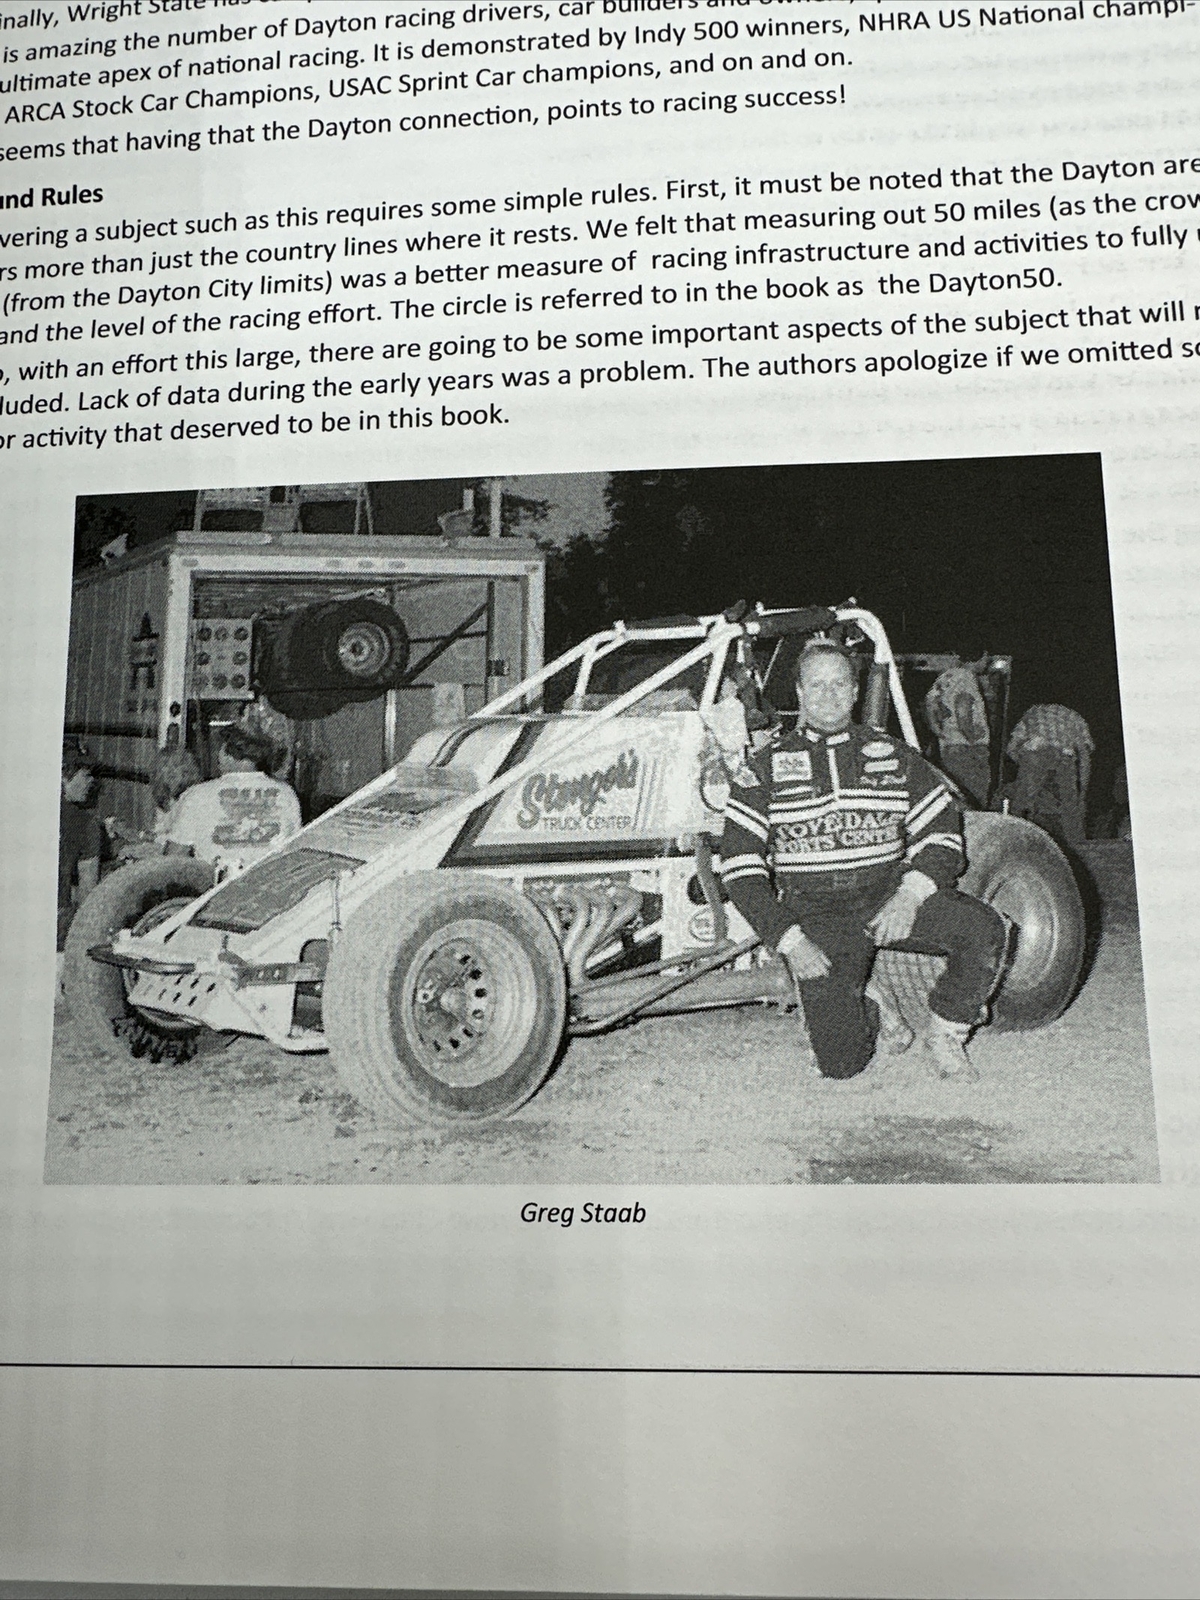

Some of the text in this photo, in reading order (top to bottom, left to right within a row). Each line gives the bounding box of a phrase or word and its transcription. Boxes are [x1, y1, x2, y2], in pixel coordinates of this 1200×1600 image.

[25, 0, 596, 62] amazing the number of Dayton racing drivers, car
[67, 0, 143, 23] Wright
[97, 0, 1085, 89] apex of national racing. It demonstrated by Indy 500 winners, NHRA US National
[3, 47, 853, 125] ARCA Stock Car Champions, USAC Sprint Car champions, and on and on.
[71, 83, 846, 157] that having that the Dayton connection, points to racing success!
[41, 183, 104, 207] Rules
[94, 159, 1155, 244] subject such as this requires some simple rules. First, must be noted that the Dayton
[2, 223, 1189, 318] (from the Dayton City limits) was better measure of racing infrastructure and activities fully
[24, 192, 1137, 280] more than just the country lines where rests. We felt that measuring out 50 miles (as the
[18, 299, 1185, 381] with effort this large, there are going be some important aspects of the subject that will
[45, 266, 1063, 342] the level of the racing effort. The circle referred to the book the Dayton50.
[78, 336, 1173, 412] Lack of data during the early years was problem. The authors apologize we omitted
[22, 402, 510, 450] activity that deserved to be this book.
[542, 815, 631, 831] TRUCK CENTER
[520, 1201, 647, 1228] Greg Staab
